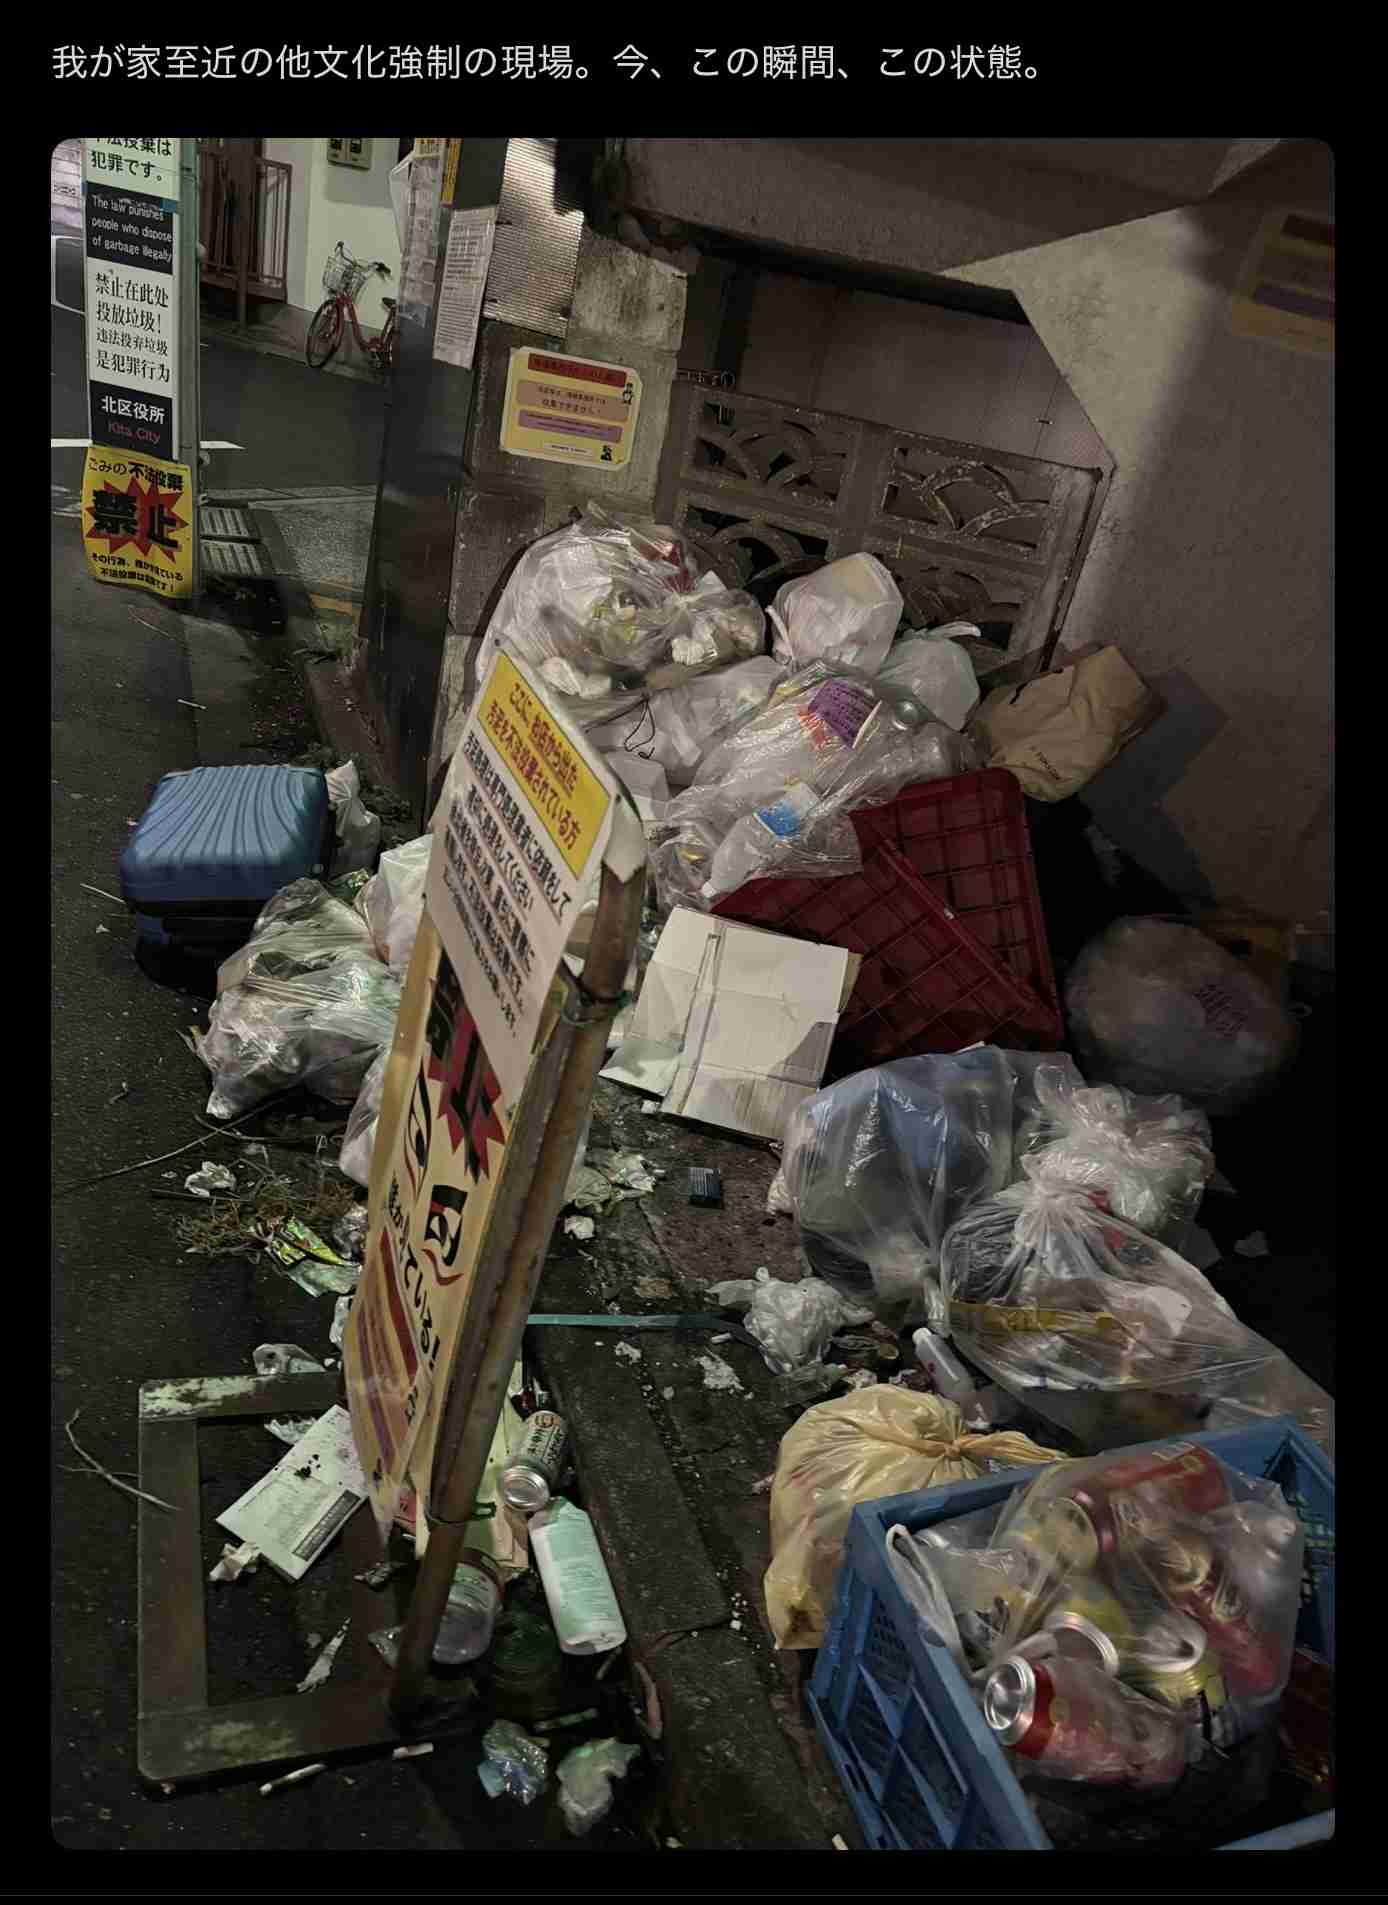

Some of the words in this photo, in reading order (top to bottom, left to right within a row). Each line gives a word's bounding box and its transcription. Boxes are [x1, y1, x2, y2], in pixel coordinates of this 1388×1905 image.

[91, 150, 162, 181] 犯罪です。
[91, 194, 109, 209] The
[111, 199, 126, 214] law
[128, 202, 164, 222] punishes
[91, 217, 119, 232] people
[121, 222, 139, 236] who
[142, 225, 172, 244] dispose
[92, 235, 102, 247] of
[104, 239, 140, 256] garbage
[142, 243, 172, 263] illegally
[95, 271, 169, 308] 禁止在此处
[95, 299, 162, 334] 投放垃圾！
[96, 327, 168, 357] 违法投弃垃圾
[95, 349, 171, 384] 是犯罪行为
[101, 395, 166, 425] 北区役所
[107, 421, 133, 440] Kita
[136, 425, 161, 445] City
[91, 489, 182, 551] 禁止
